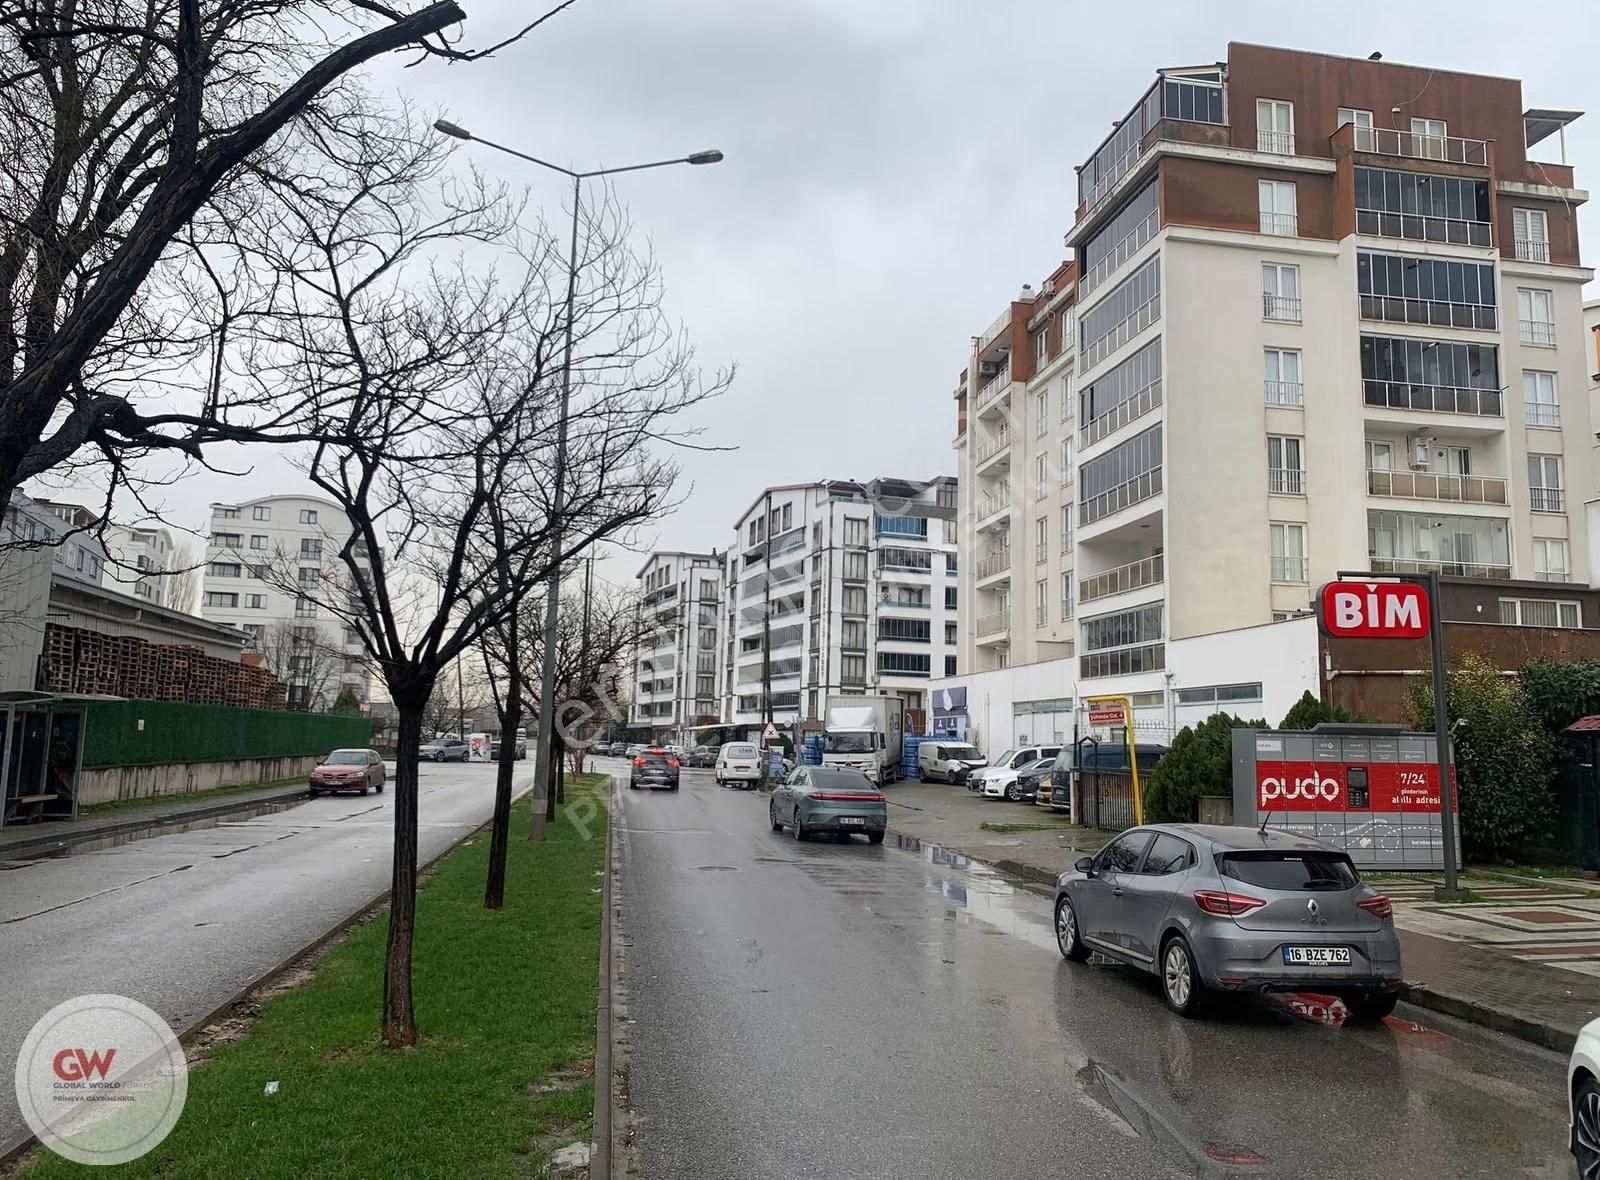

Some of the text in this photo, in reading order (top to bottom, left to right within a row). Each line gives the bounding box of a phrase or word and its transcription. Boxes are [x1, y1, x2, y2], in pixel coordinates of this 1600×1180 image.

[1335, 584, 1422, 629] BİM
[1261, 770, 1340, 808] pudo
[1400, 772, 1425, 785] 7/24
[1290, 948, 1349, 961] 16 BZE 762
